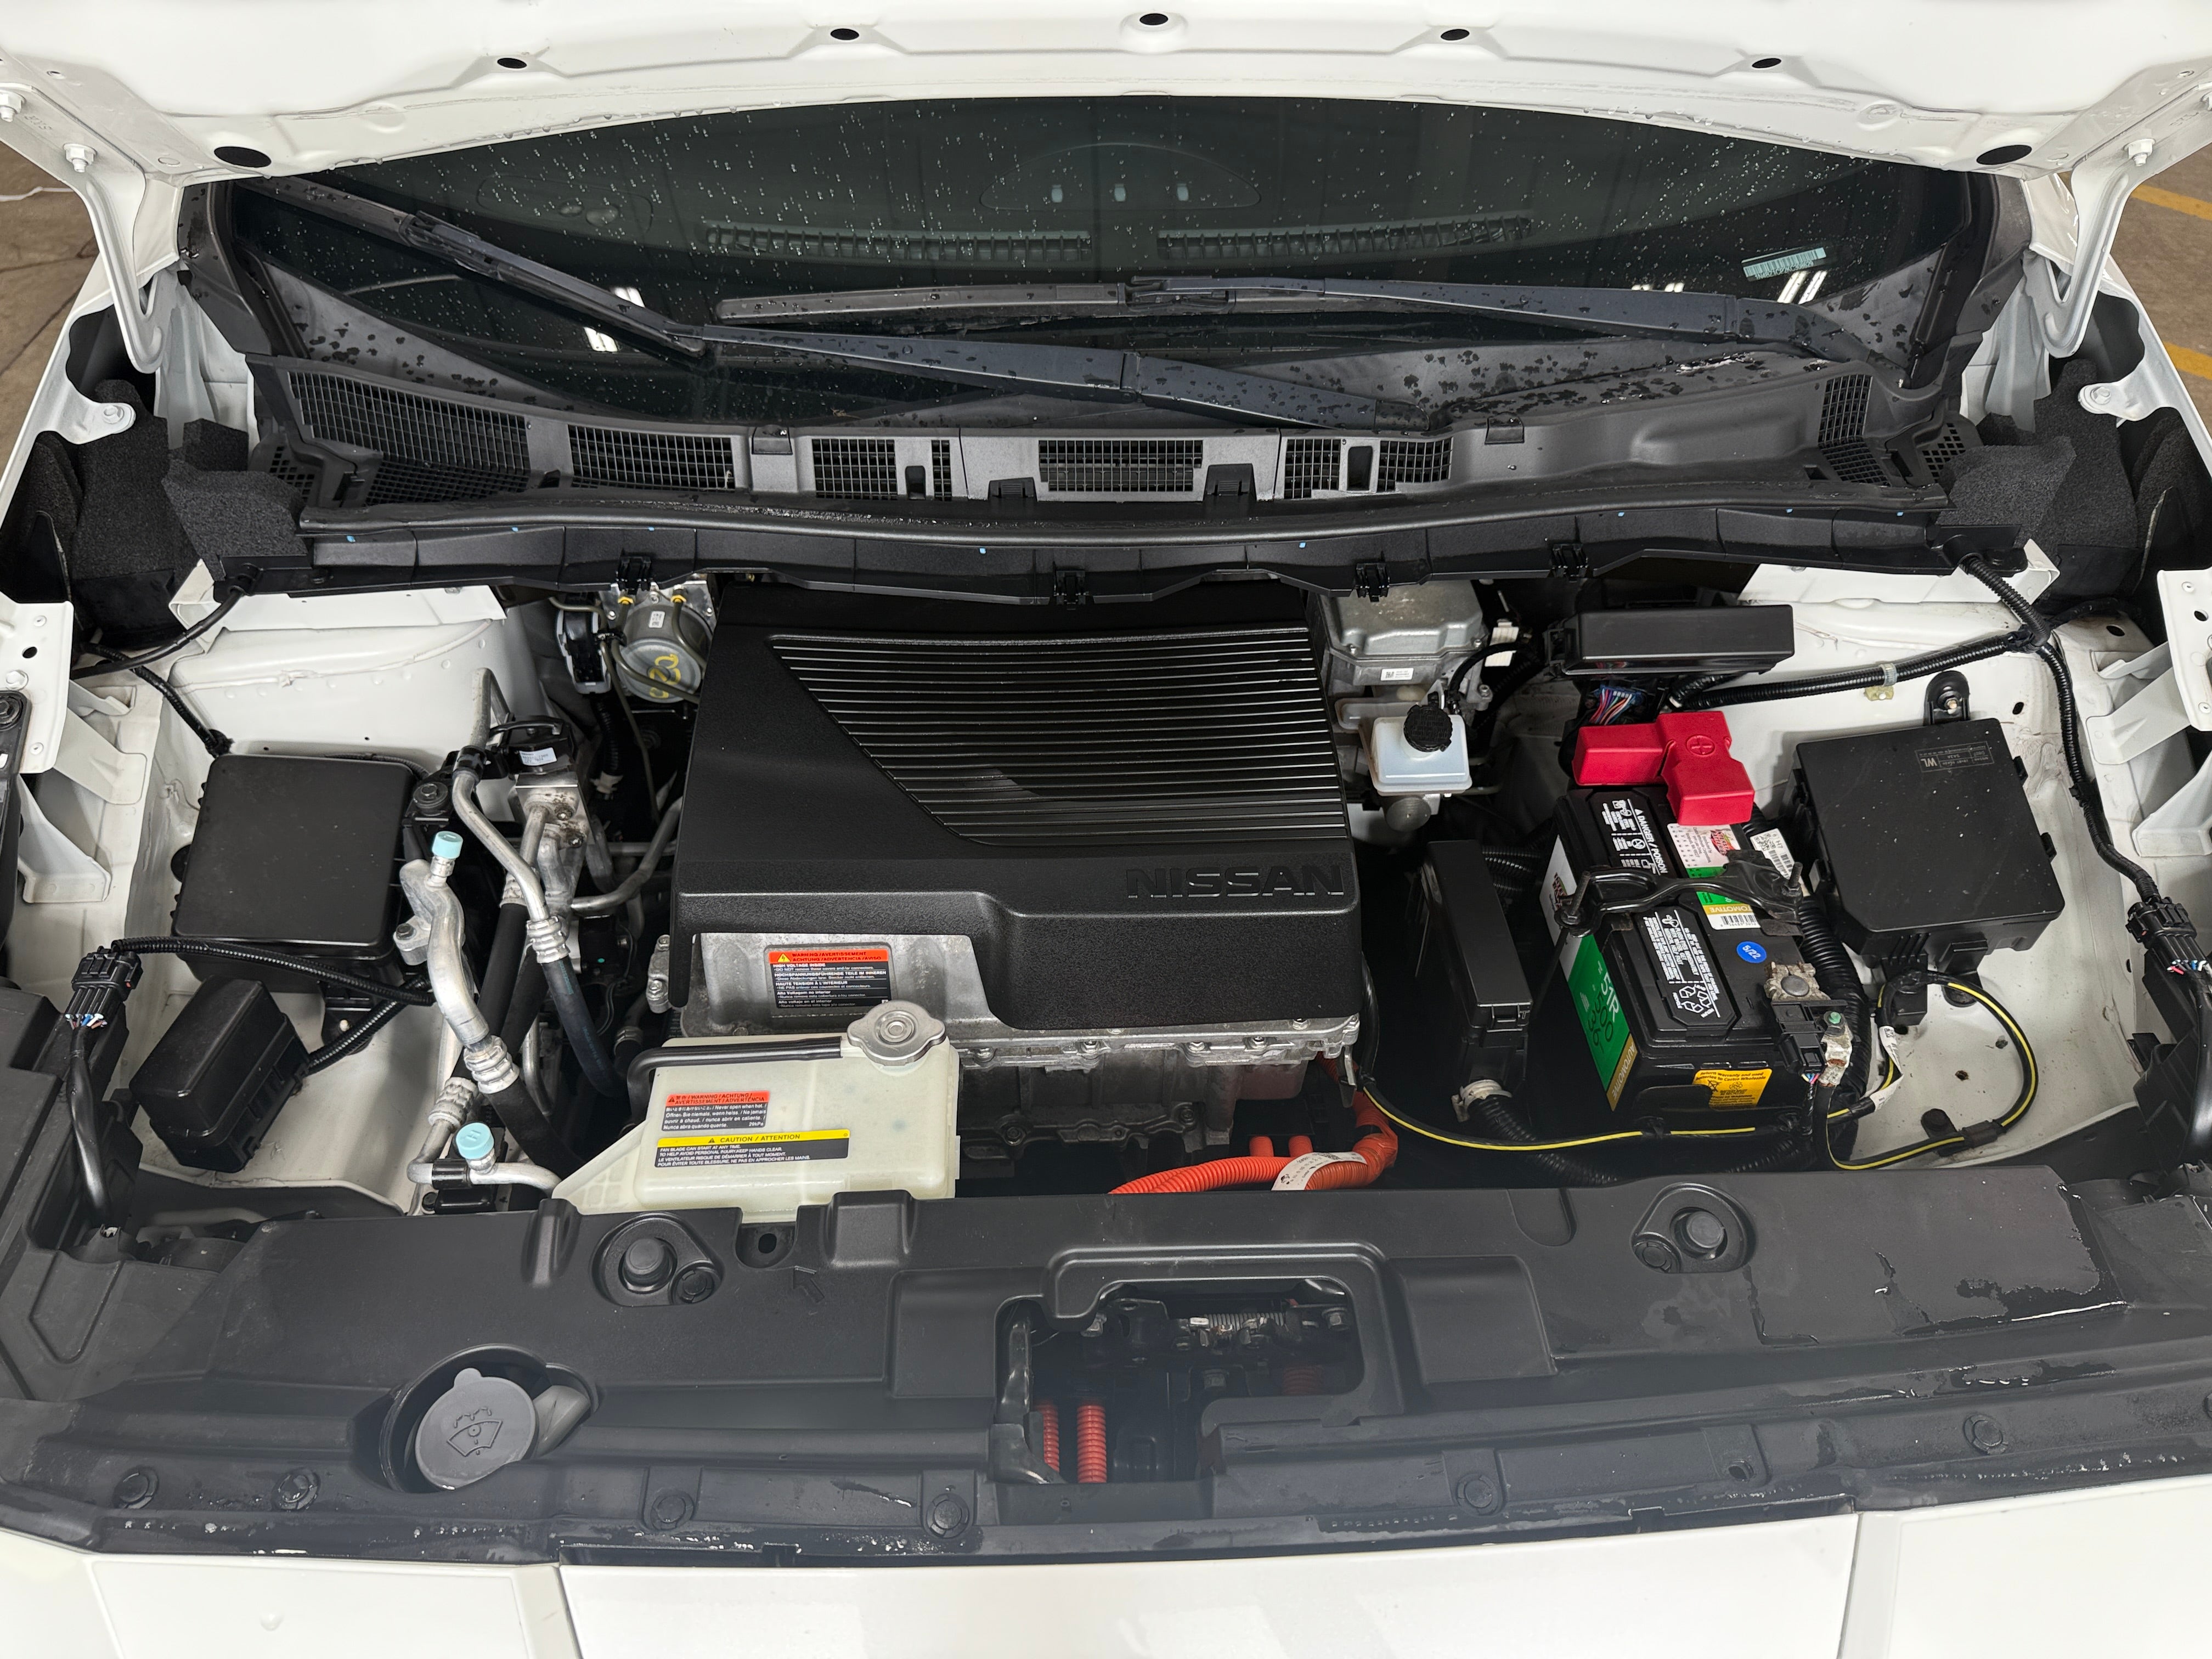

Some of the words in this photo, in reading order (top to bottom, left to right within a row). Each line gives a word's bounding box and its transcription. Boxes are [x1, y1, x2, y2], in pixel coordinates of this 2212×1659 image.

[1921, 758, 1938, 768] WL
[1637, 815, 1655, 842] DANGER
[1651, 848, 1668, 873] POISON
[1126, 865, 1344, 899] NISSAN
[1742, 945, 1762, 960] 5/22
[1595, 992, 1613, 1042] 500
[1601, 971, 1620, 1023] 51R
[1612, 1041, 1636, 1101] AUTOMOTIVE
